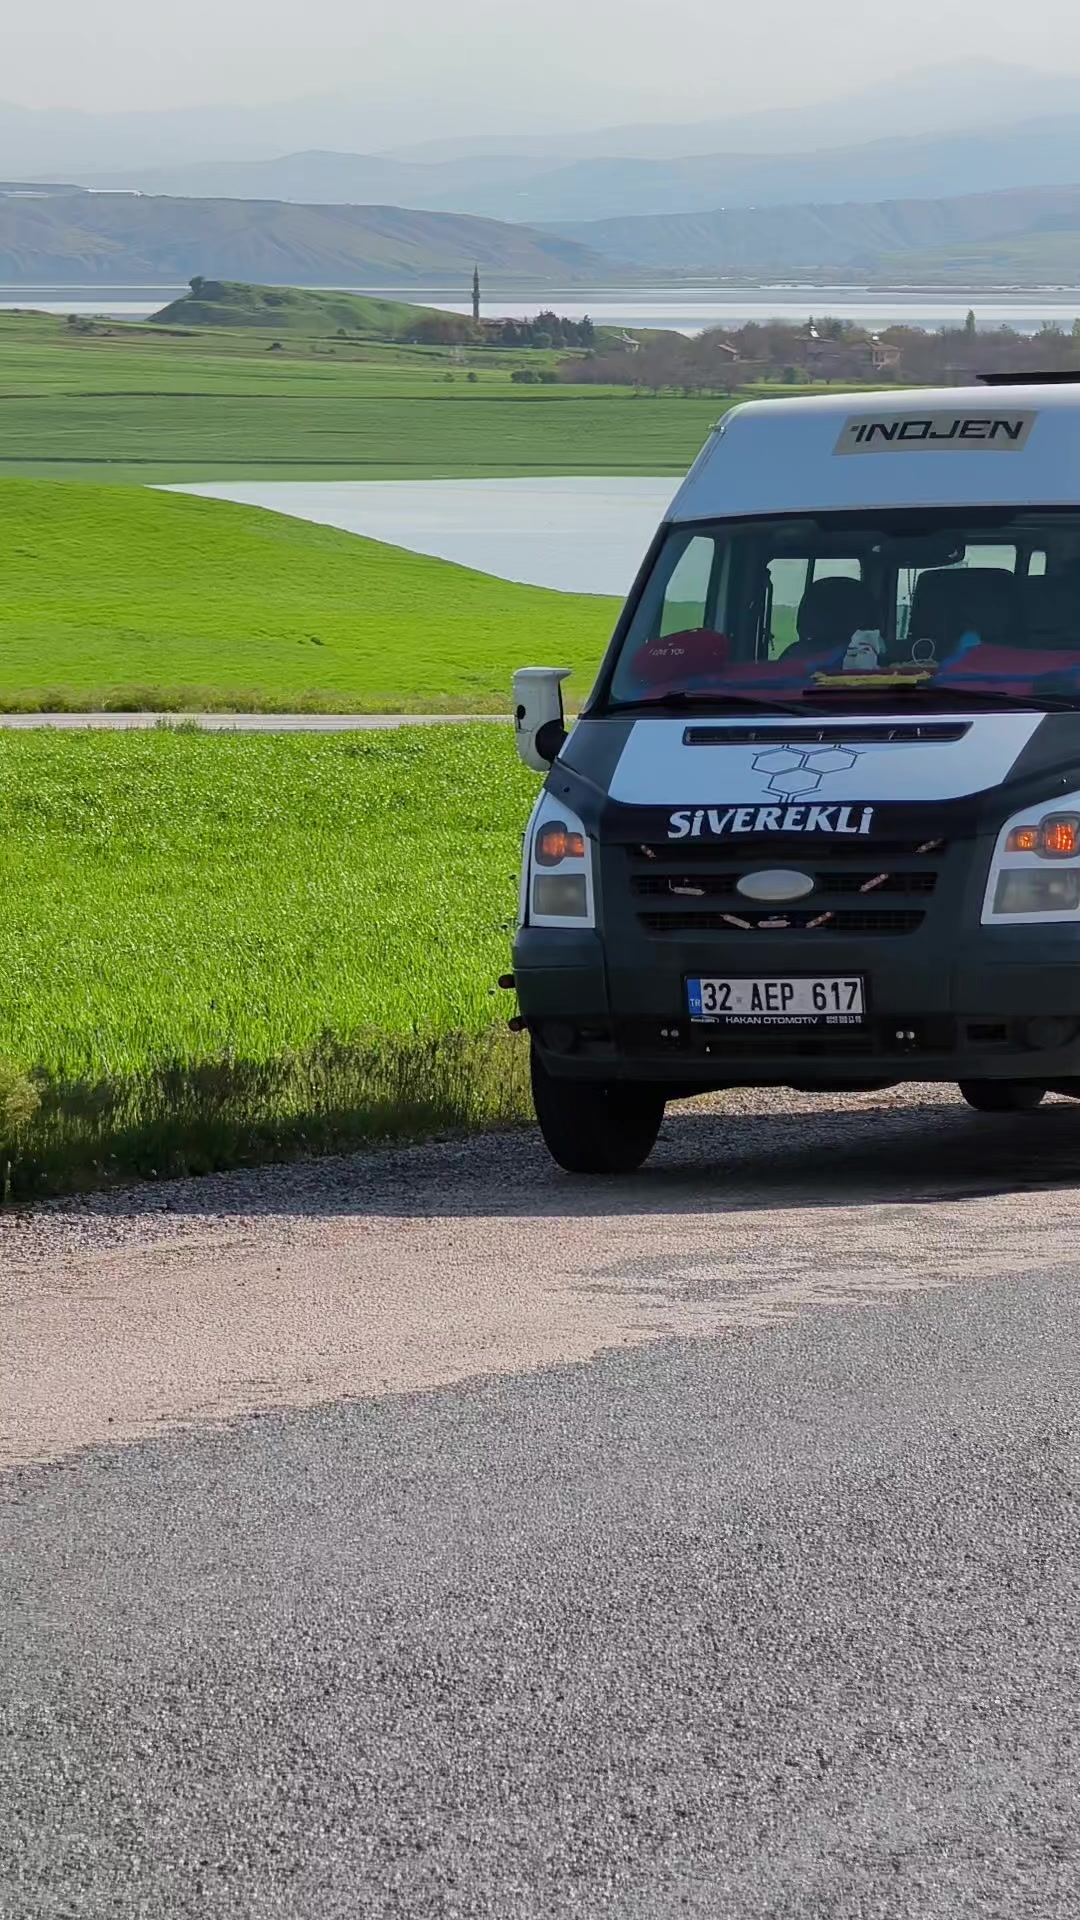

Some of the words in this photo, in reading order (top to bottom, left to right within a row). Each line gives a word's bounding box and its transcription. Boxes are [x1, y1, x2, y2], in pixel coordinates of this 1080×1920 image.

[690, 998, 701, 1007] TR
[703, 982, 733, 1011] 32
[751, 982, 794, 1011] AEP
[812, 981, 858, 1011] 617
[725, 1016, 762, 1024] HAKAN
